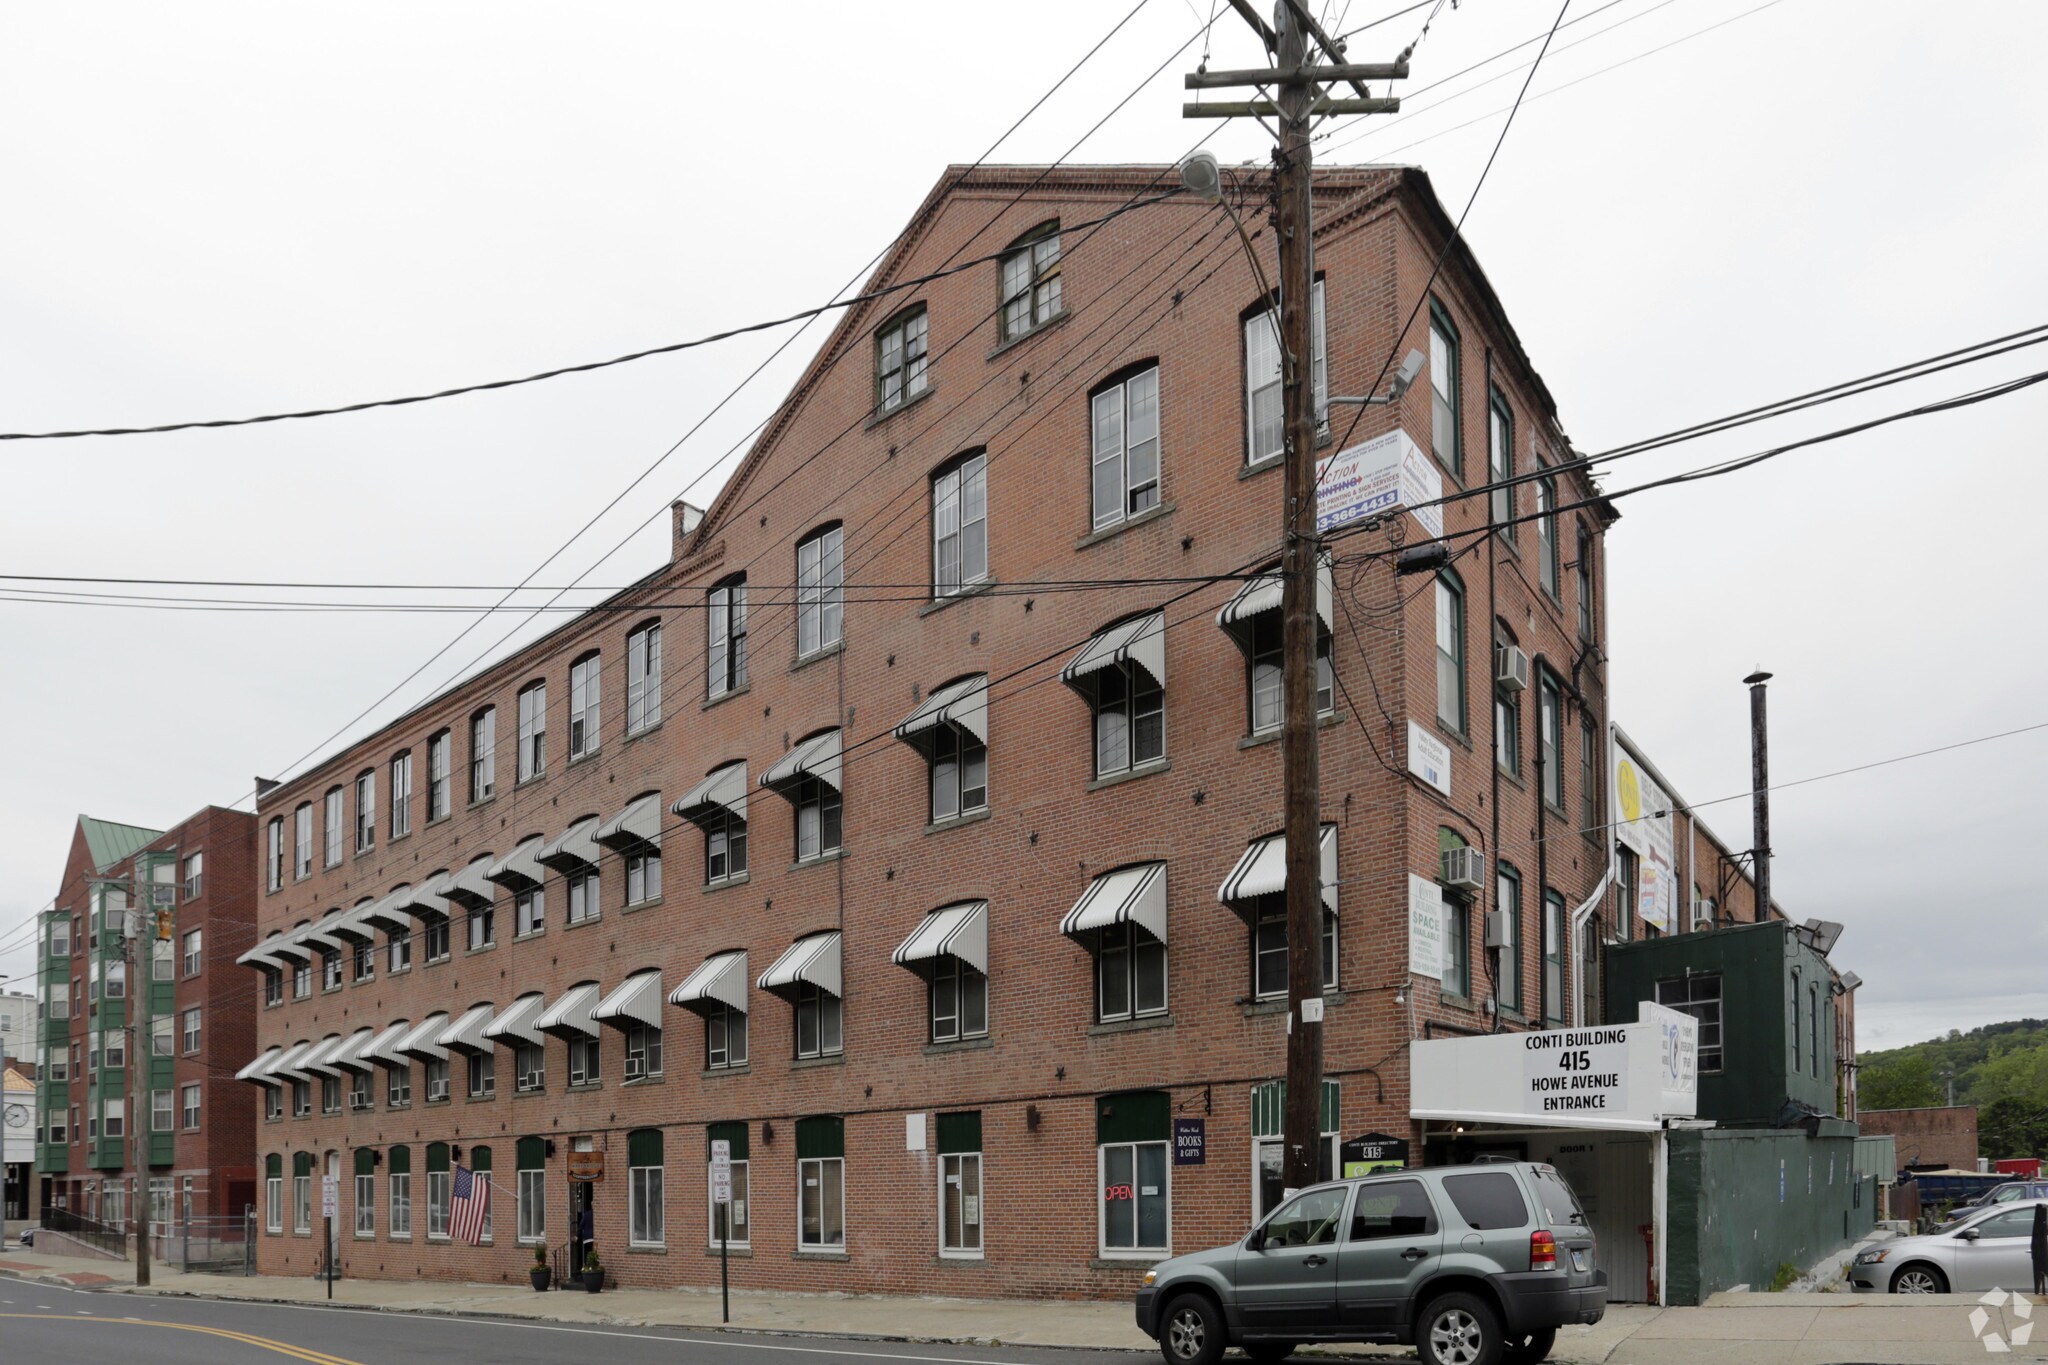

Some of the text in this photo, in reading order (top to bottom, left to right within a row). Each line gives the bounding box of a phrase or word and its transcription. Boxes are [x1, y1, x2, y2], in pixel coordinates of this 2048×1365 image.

[1316, 477, 1357, 499] RINTING
[1327, 492, 1351, 505] PRINTING
[1359, 484, 1372, 493] SIGN
[1373, 473, 1399, 487] SERVICES
[1364, 490, 1375, 498] CAN
[1376, 484, 1392, 493] PRINT
[1317, 493, 1395, 529] 3-366-4413
[1413, 911, 1440, 931] SPACE
[1413, 927, 1440, 942] AVAILABLE
[1526, 1030, 1626, 1049] CONTI BUILDING
[1559, 1051, 1591, 1071] 415
[1532, 1074, 1618, 1092] HOWE AVENUE
[1544, 1094, 1606, 1111] ENTRANCE
[1178, 1136, 1201, 1146] BOOKS
[1560, 1145, 1585, 1153] DOOR
[1185, 1149, 1199, 1157] GIFTS
[1364, 1147, 1380, 1158] 415
[1105, 1186, 1134, 1200] OPEN
